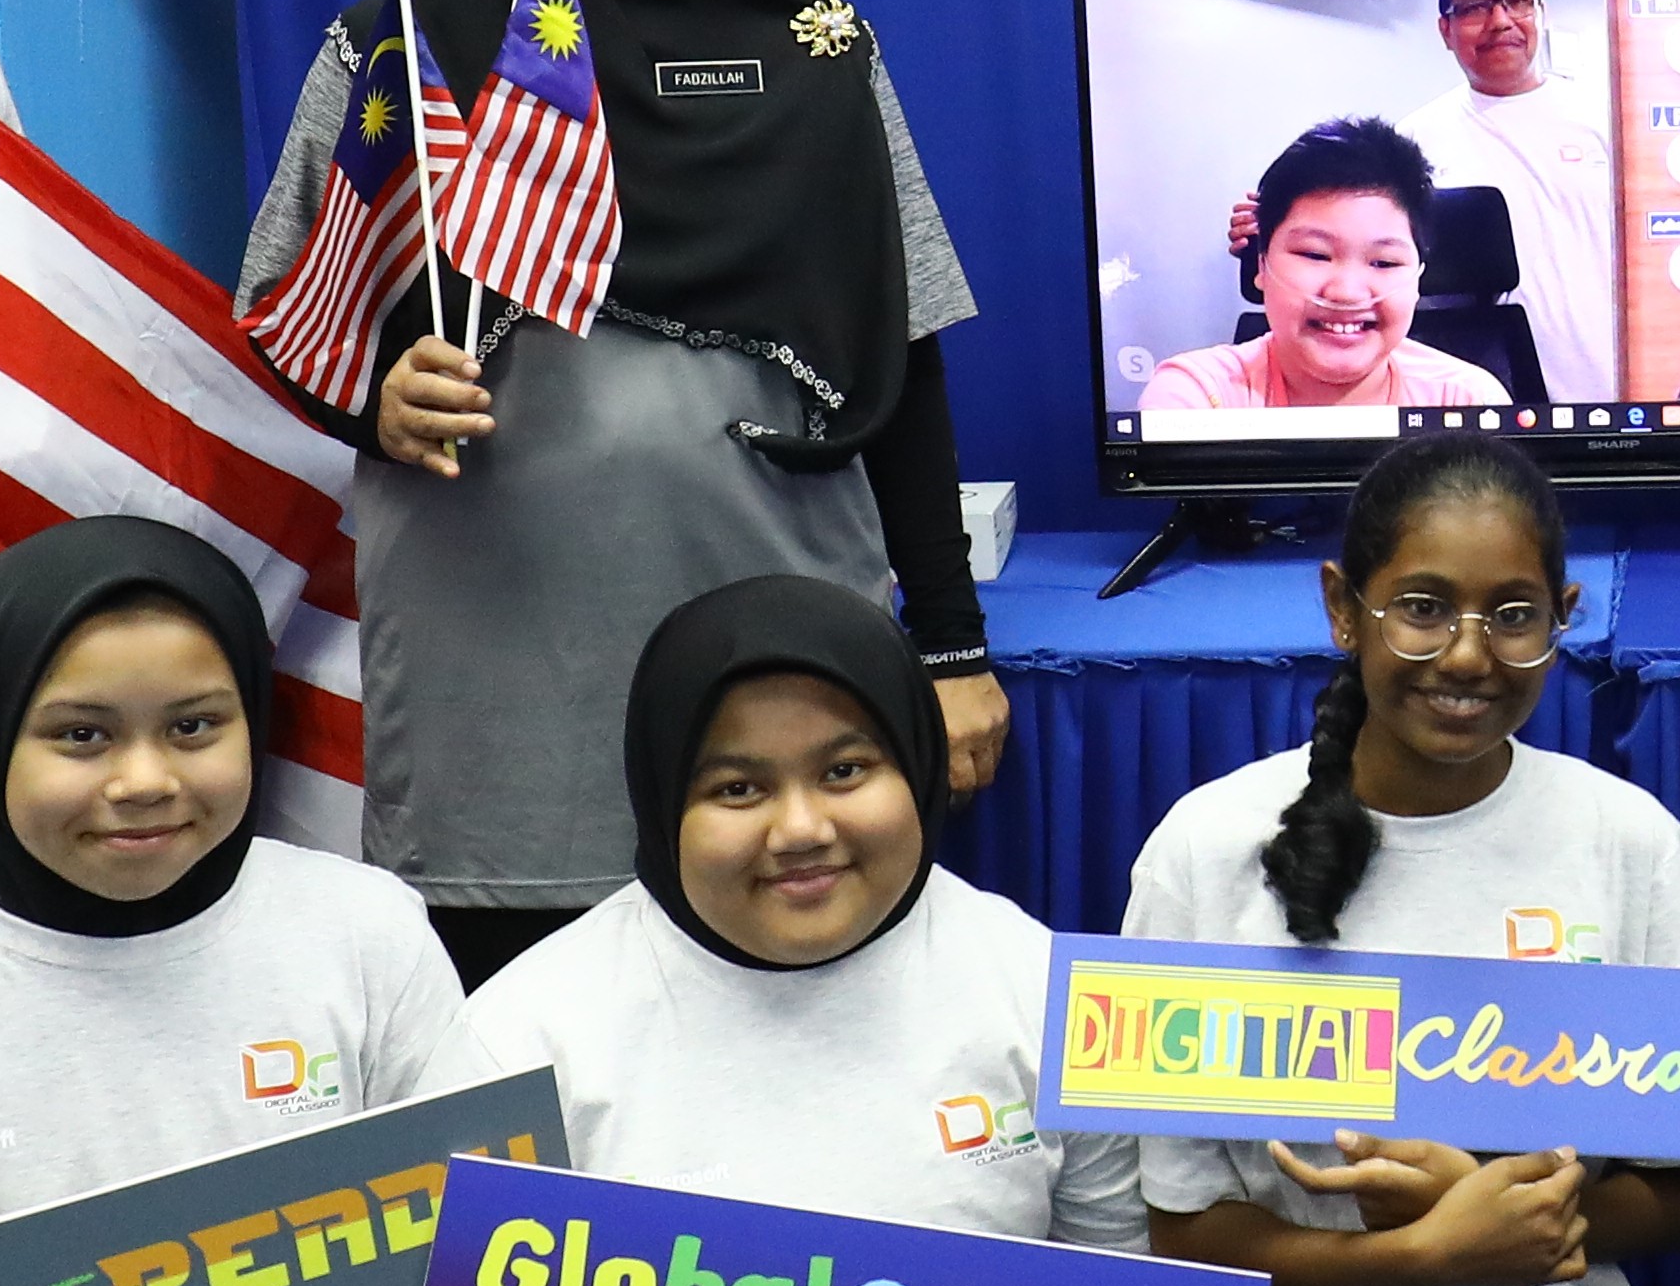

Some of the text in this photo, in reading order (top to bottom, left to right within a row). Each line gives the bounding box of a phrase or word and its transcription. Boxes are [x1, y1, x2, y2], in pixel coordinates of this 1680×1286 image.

[674, 71, 744, 85] FADZILLAH
[1586, 438, 1641, 451] SHARP
[1068, 992, 1395, 1085] DIGITAL
[264, 1095, 312, 1109] DIGITAL
[961, 1145, 1000, 1161] DIGITAL
